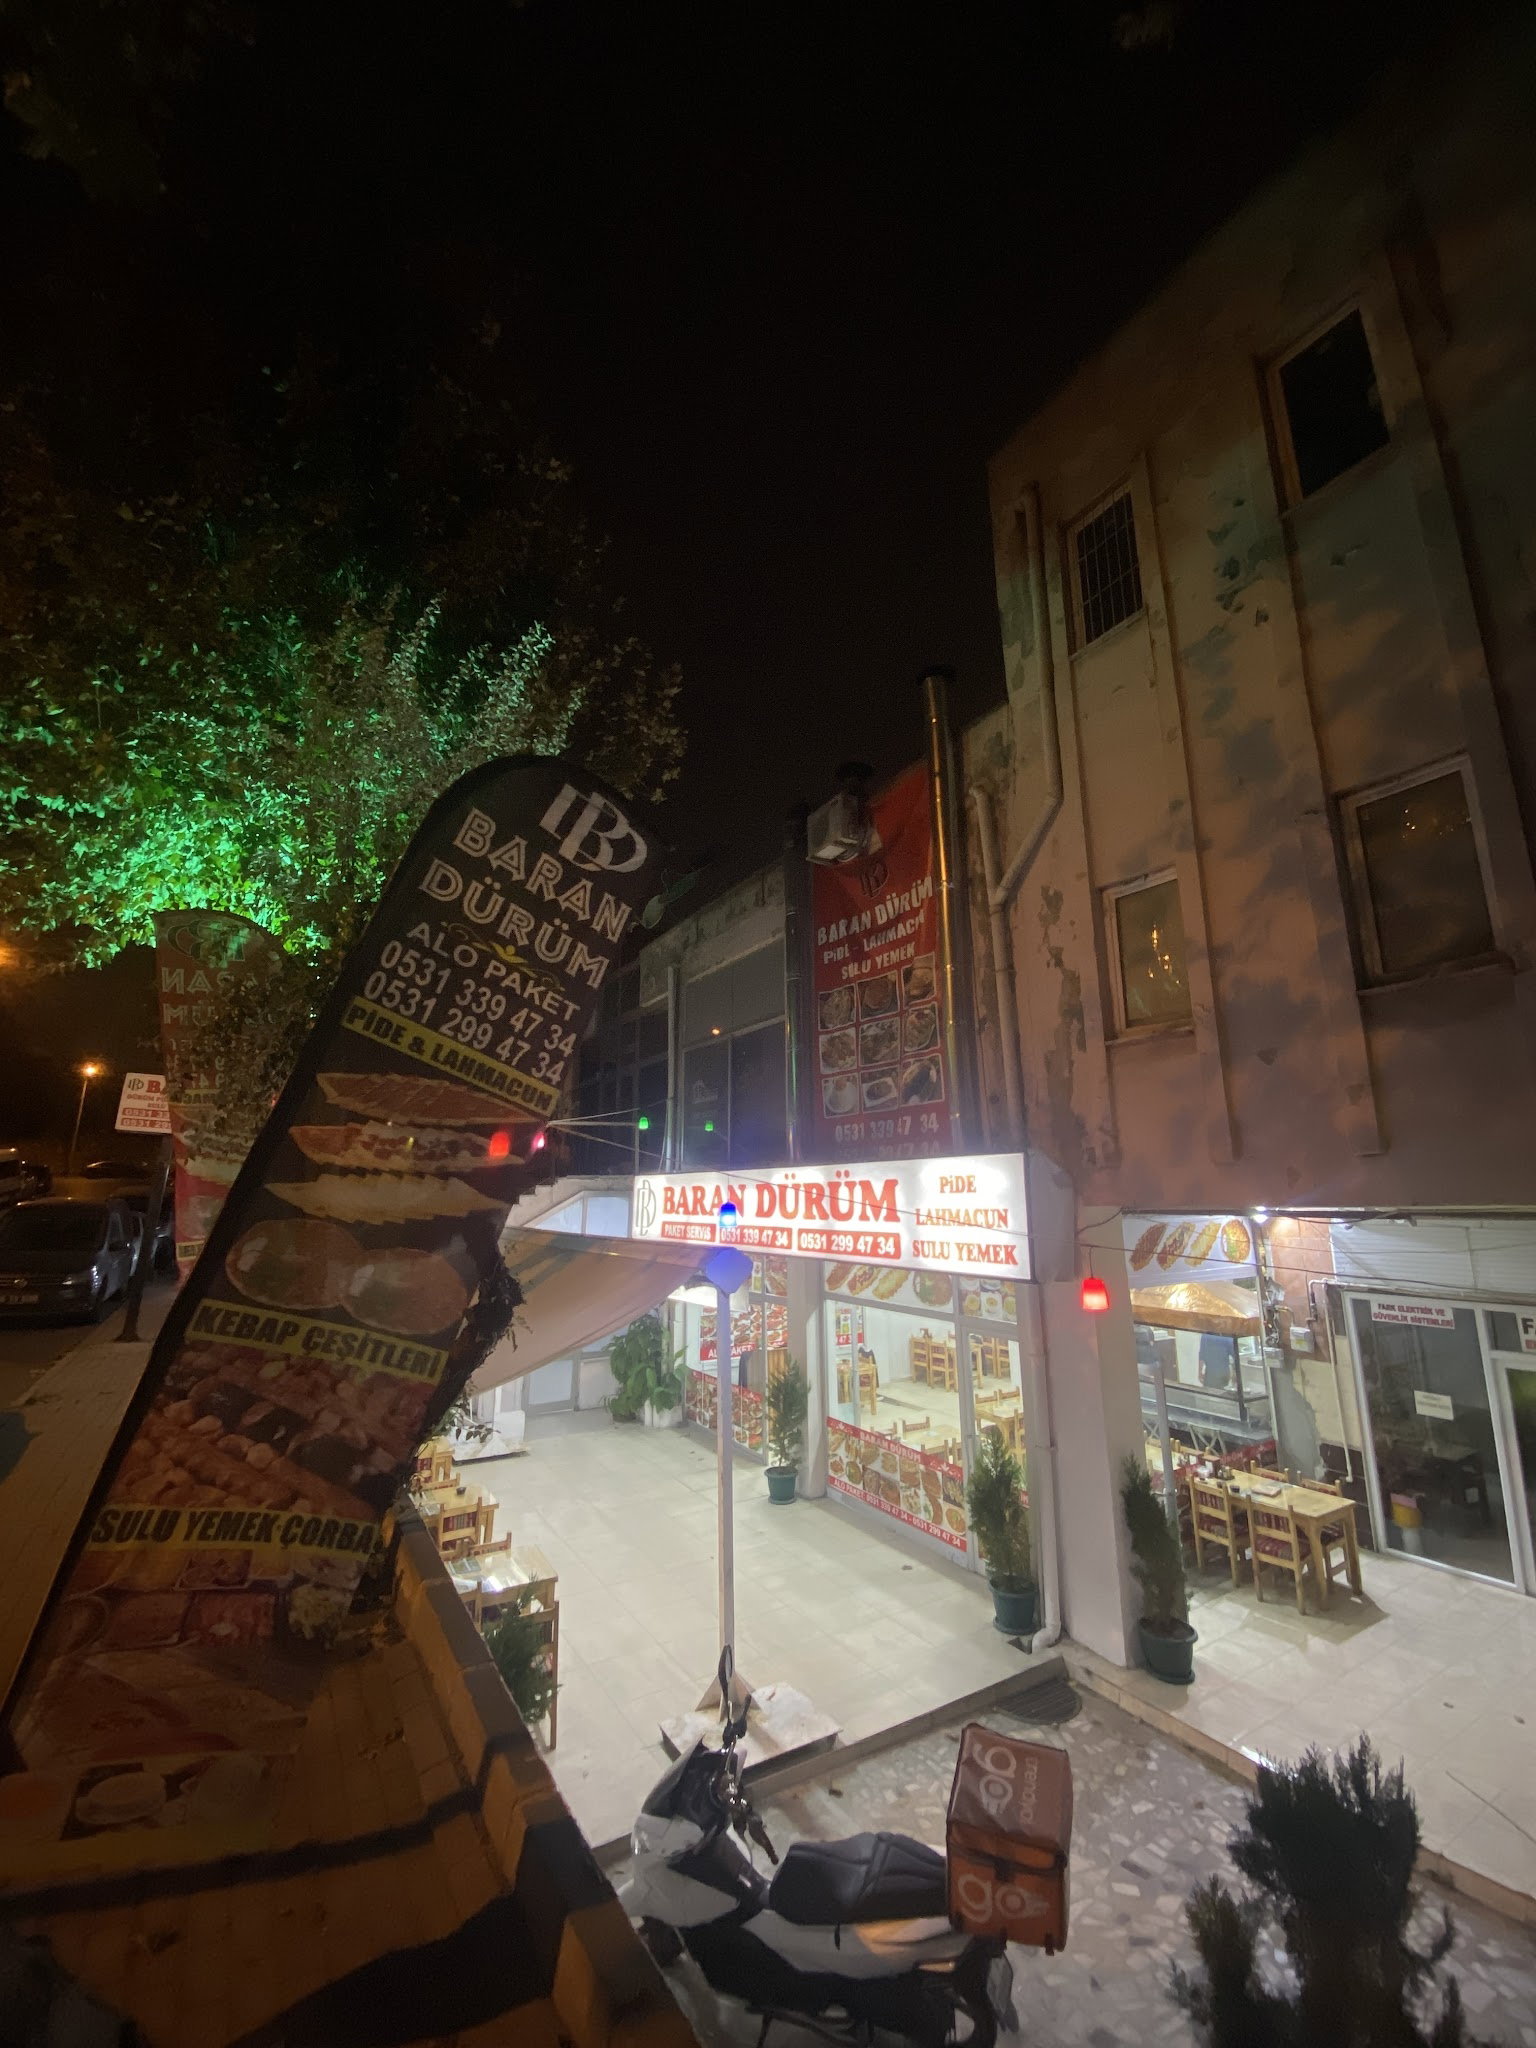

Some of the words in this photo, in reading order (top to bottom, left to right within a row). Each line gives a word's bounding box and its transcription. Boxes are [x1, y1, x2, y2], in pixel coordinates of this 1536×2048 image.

[452, 807, 633, 943] BARAN
[406, 921, 480, 968] ALO
[419, 857, 610, 989] DÜRÜM
[818, 910, 872, 946] BARAN
[875, 942, 916, 969] YEMEK
[380, 940, 453, 994] 0531
[456, 979, 507, 1021] 339
[510, 1007, 545, 1038] 47
[544, 1024, 578, 1058] 34
[483, 960, 581, 1021] PAKET
[364, 971, 438, 1024] 0531
[439, 1008, 494, 1049] 299
[496, 1036, 532, 1067] 47
[530, 1052, 565, 1085] 34
[408, 1036, 425, 1056] &
[429, 1043, 556, 1113] LAHMACUN
[663, 1184, 747, 1218] BARAN
[755, 1170, 900, 1222] DÜRÜM
[721, 1228, 740, 1241] 0531
[743, 1229, 759, 1242] 339
[761, 1230, 773, 1244] 47
[775, 1231, 789, 1246] 34
[915, 1208, 1008, 1229] LAHMACUN
[800, 1233, 827, 1250] 0531
[831, 1234, 854, 1252] 299
[857, 1235, 873, 1253] 47
[877, 1236, 895, 1255] 34
[912, 1240, 950, 1260] SULU
[954, 1242, 1018, 1265] YEMEK
[193, 1305, 300, 1345] KEBAP
[92, 1509, 180, 1543] SULU
[183, 1511, 280, 1543] YEMEK
